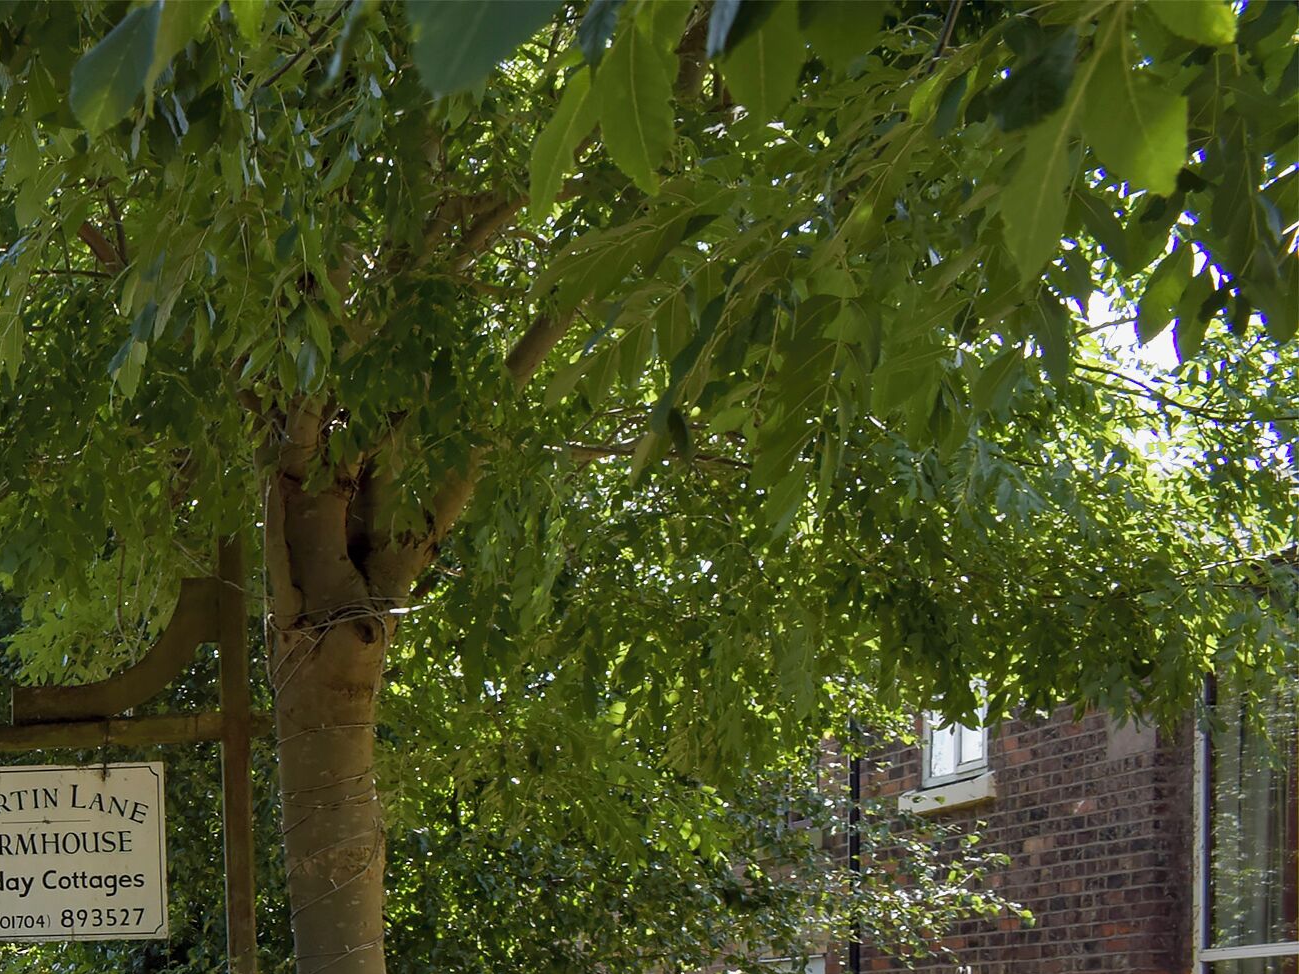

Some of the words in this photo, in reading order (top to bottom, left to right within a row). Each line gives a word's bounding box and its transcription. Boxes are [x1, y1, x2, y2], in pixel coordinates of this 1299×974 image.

[71, 784, 149, 825] LANE
[42, 870, 145, 896] Cottages
[61, 908, 145, 928] 893527
